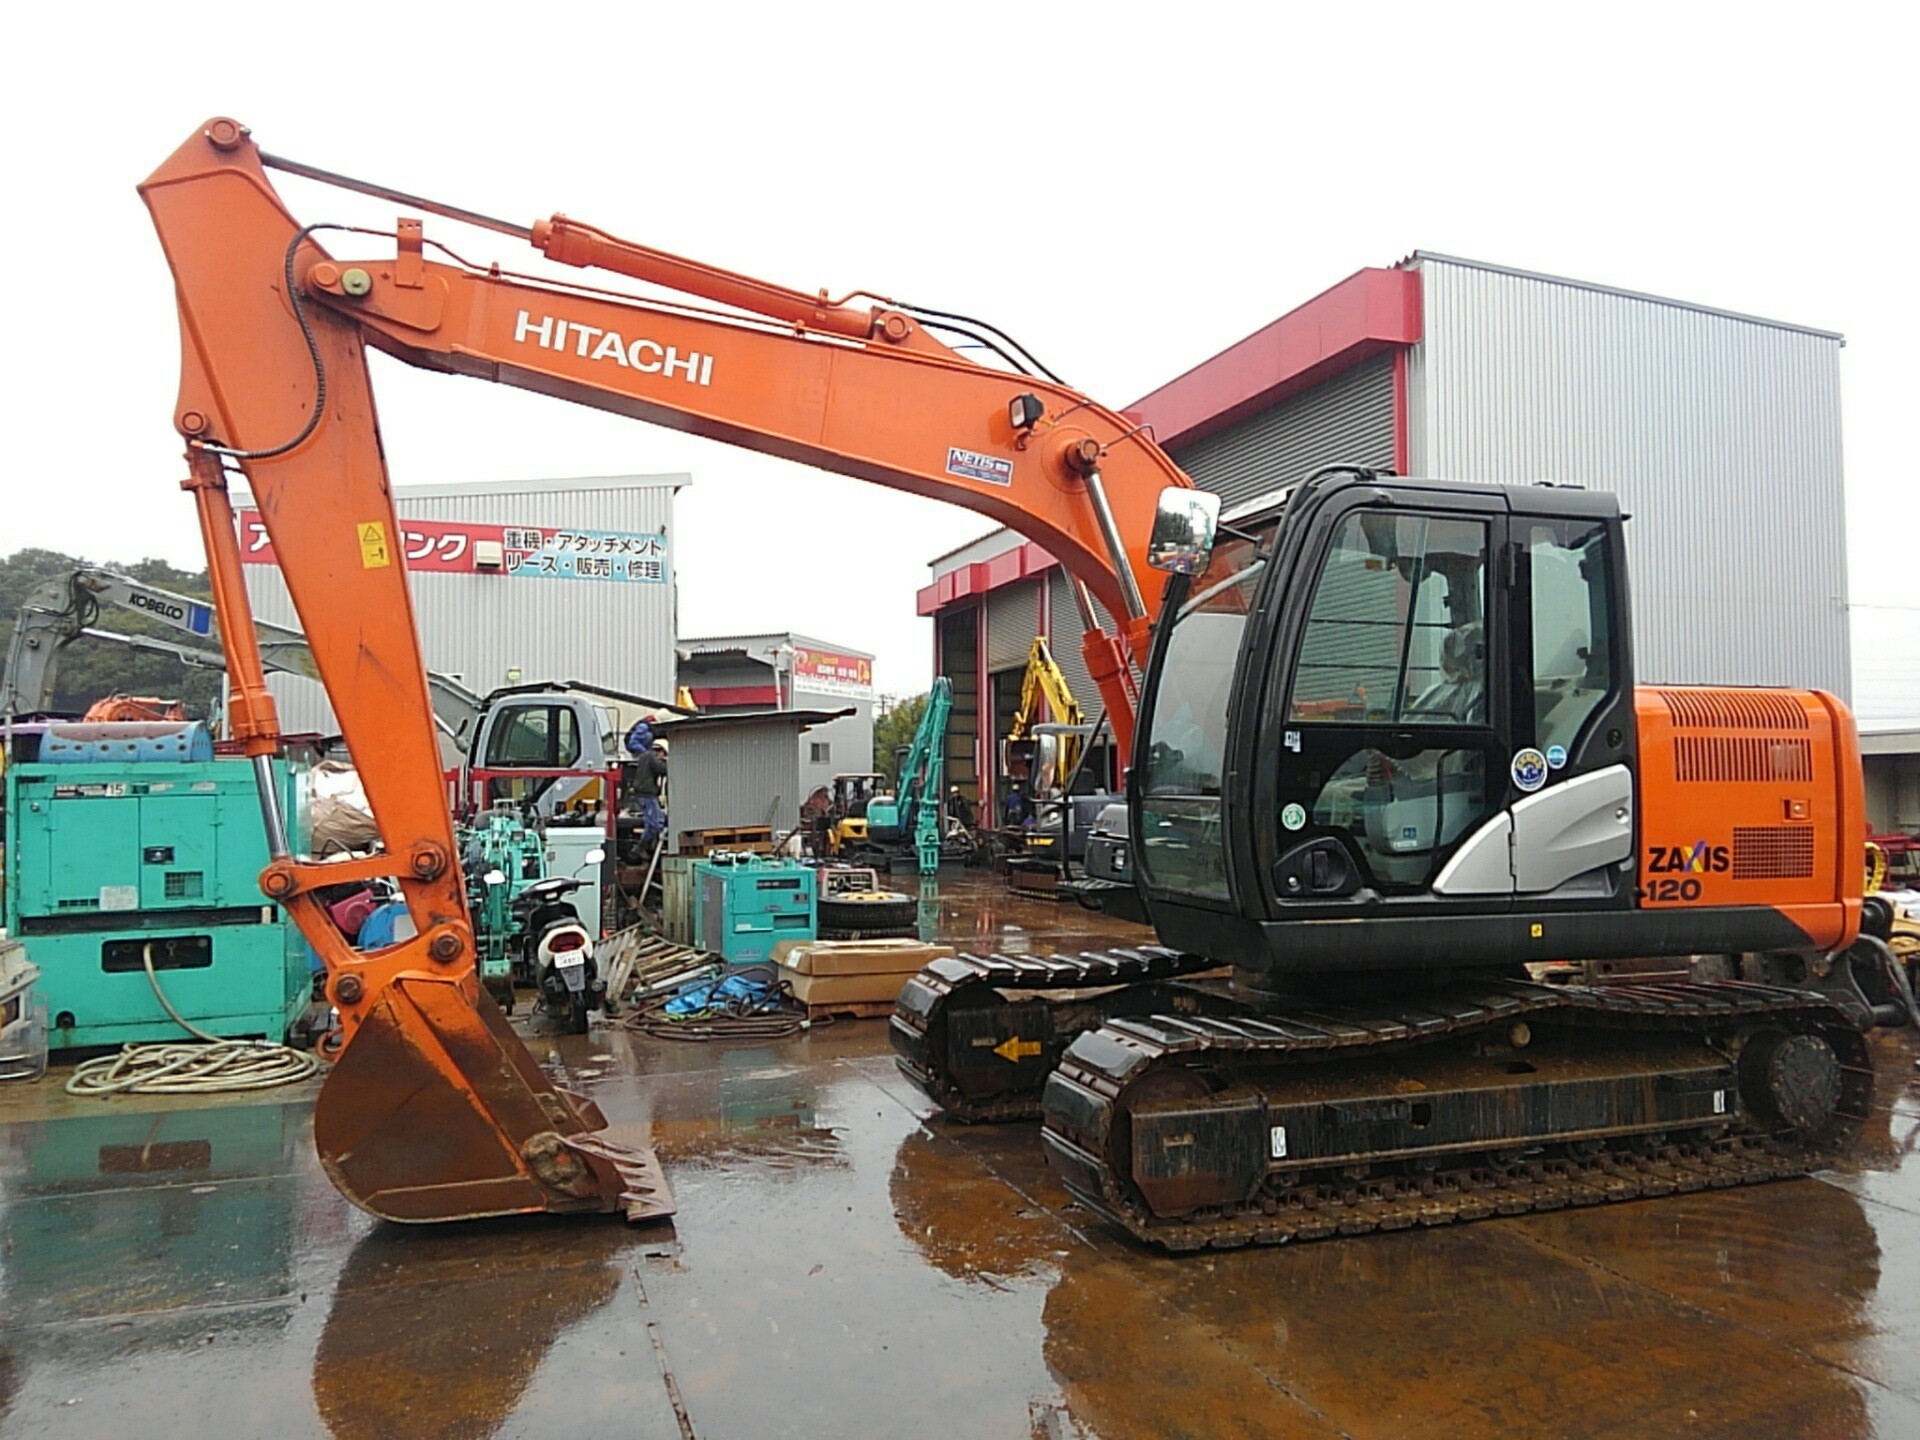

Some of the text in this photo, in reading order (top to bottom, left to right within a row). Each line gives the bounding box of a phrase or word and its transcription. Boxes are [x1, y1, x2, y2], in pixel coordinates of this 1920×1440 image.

[514, 309, 714, 387] HITACHI
[952, 449, 996, 469] NETIS
[507, 553, 662, 579] リース・販売・修理
[128, 592, 184, 620] KOBELCO
[1648, 840, 1730, 874] ZAXIS
[1646, 878, 1702, 902] 120
